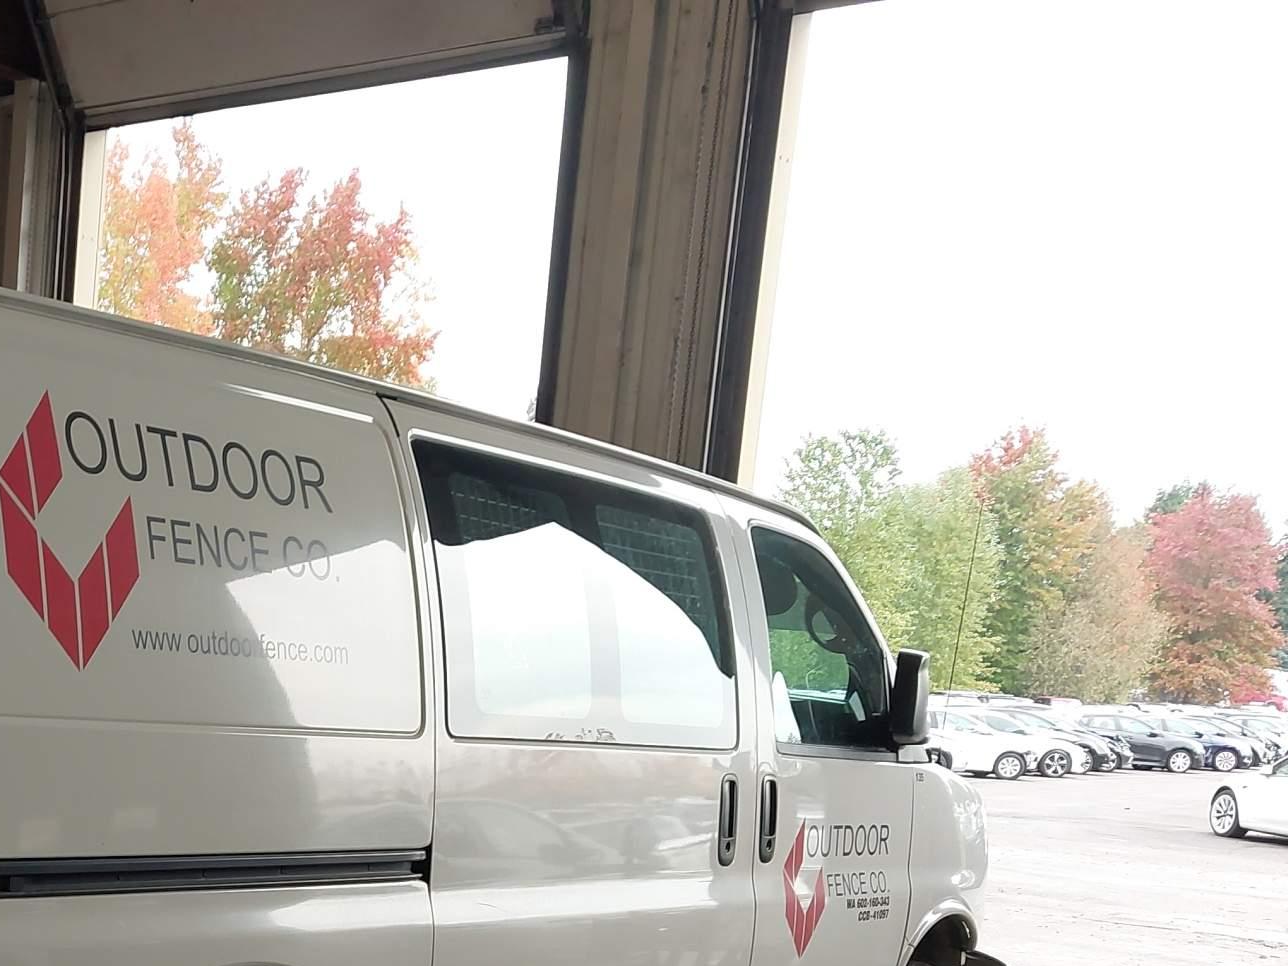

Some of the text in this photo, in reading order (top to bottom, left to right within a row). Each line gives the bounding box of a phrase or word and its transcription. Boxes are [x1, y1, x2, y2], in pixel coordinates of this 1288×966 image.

[65, 411, 333, 513] OUTDOOR
[146, 516, 341, 583] FENCE CO.
[131, 628, 349, 665] wwwoutdoofence.com
[806, 824, 890, 858] OUTDOOR
[826, 871, 890, 897] FENCE CO.
